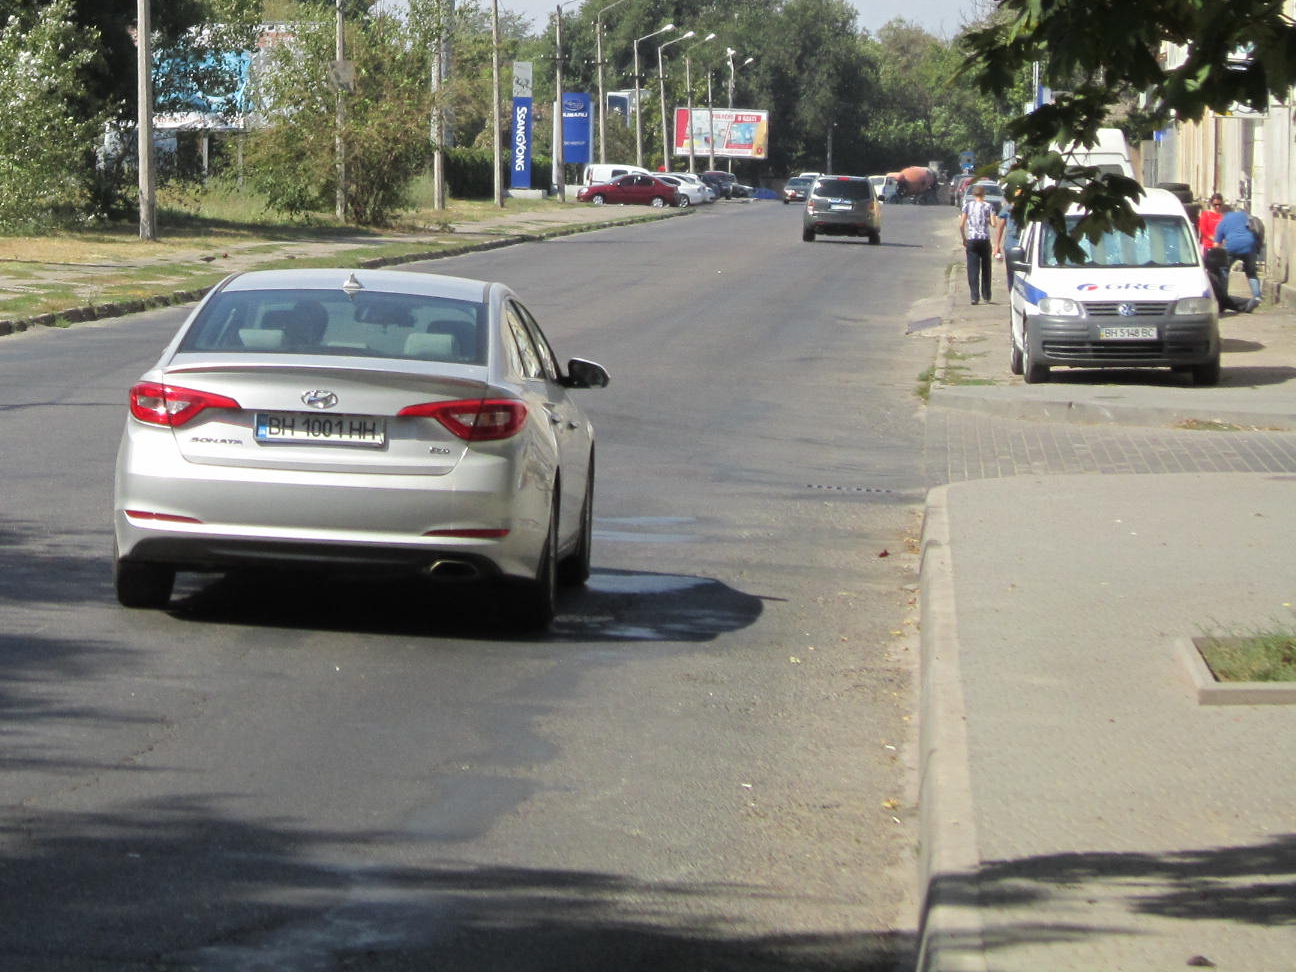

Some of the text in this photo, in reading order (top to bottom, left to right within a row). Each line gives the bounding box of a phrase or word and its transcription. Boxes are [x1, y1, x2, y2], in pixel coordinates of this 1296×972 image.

[515, 106, 528, 172] SSANGYONG
[269, 417, 376, 440] BH 1001 HH
